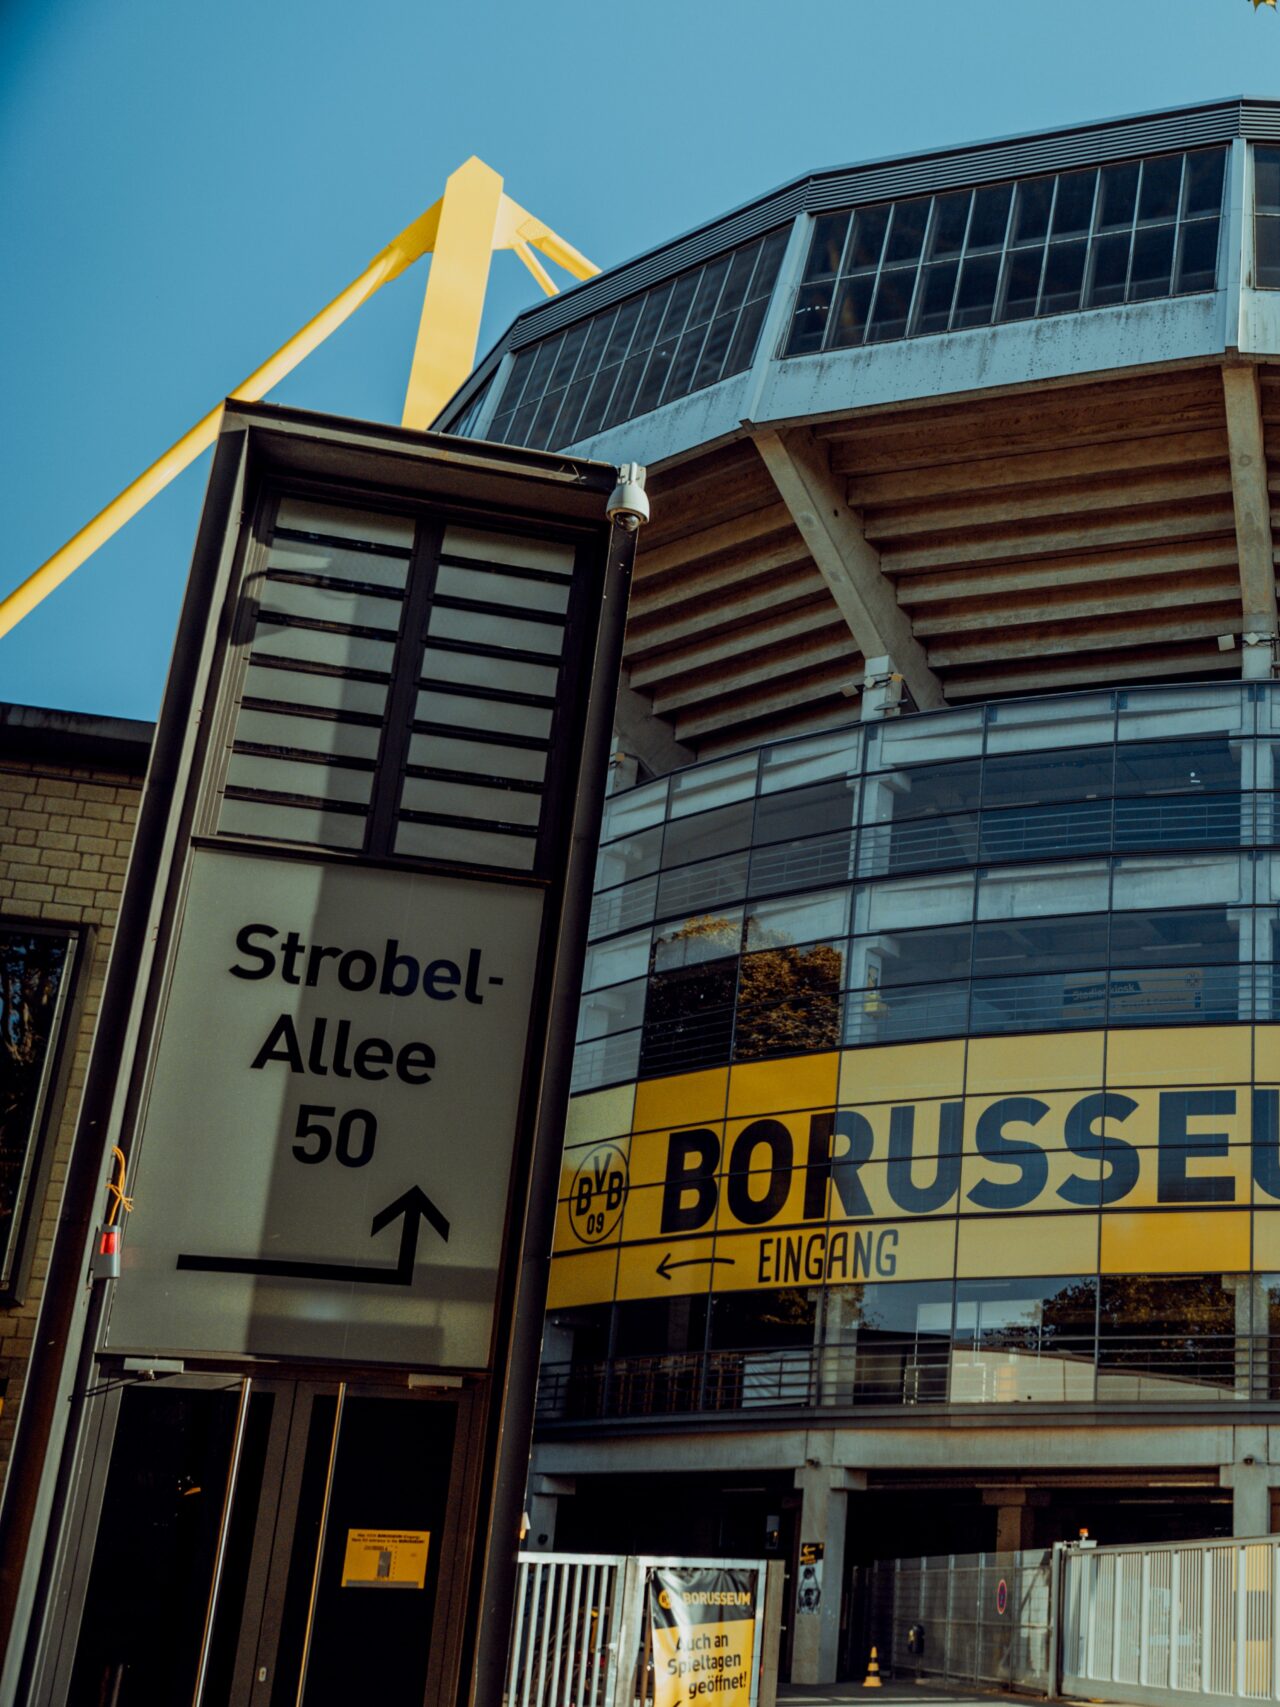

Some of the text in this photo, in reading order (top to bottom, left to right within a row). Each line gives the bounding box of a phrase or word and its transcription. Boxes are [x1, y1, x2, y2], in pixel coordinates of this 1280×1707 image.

[229, 922, 503, 1004] Strobel-
[250, 1013, 437, 1085] Allee
[291, 1103, 378, 1169] 50
[576, 1152, 624, 1216] BVB
[587, 1212, 605, 1235] 09
[757, 1228, 899, 1283] EINGANG
[682, 1591, 751, 1606] BORUSSEUM
[714, 1634, 729, 1648] an
[667, 1653, 742, 1678] Spieltagen
[688, 1671, 748, 1700] geöffnet!
